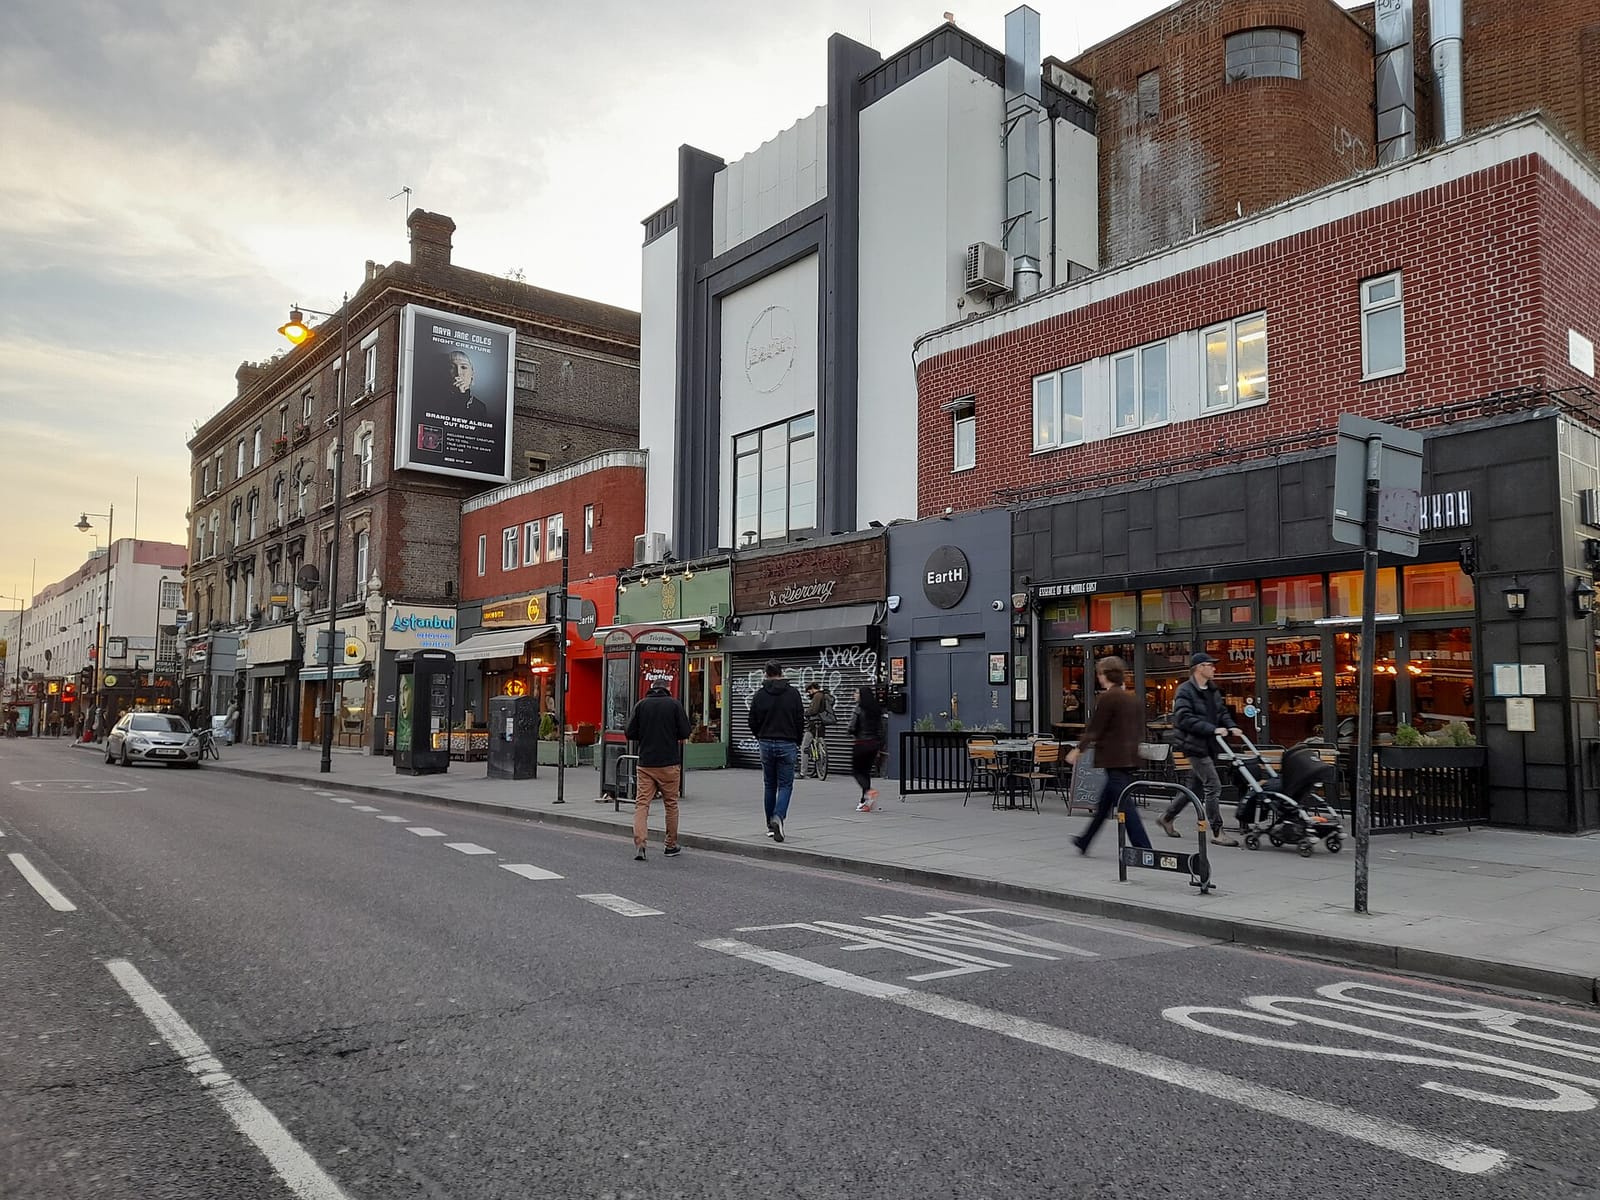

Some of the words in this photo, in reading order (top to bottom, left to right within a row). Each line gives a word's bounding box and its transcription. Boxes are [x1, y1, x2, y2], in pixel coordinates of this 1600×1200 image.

[432, 325, 451, 337] MAYA
[454, 331, 469, 341] JANE
[472, 334, 492, 346] COLES
[432, 336, 454, 345] NIGHT
[455, 342, 491, 354] CREATURE
[425, 412, 451, 421] BRAND
[468, 420, 493, 428] ALBUM
[927, 568, 963, 585] EartH
[768, 590, 778, 607] &
[779, 578, 836, 605] Piercing
[1038, 586, 1057, 597] ESSENCE
[1056, 585, 1062, 595] OF
[1062, 584, 1071, 595] THE
[1071, 583, 1086, 594] MIDDLE
[1086, 582, 1098, 592] EAST
[578, 614, 595, 625] artH
